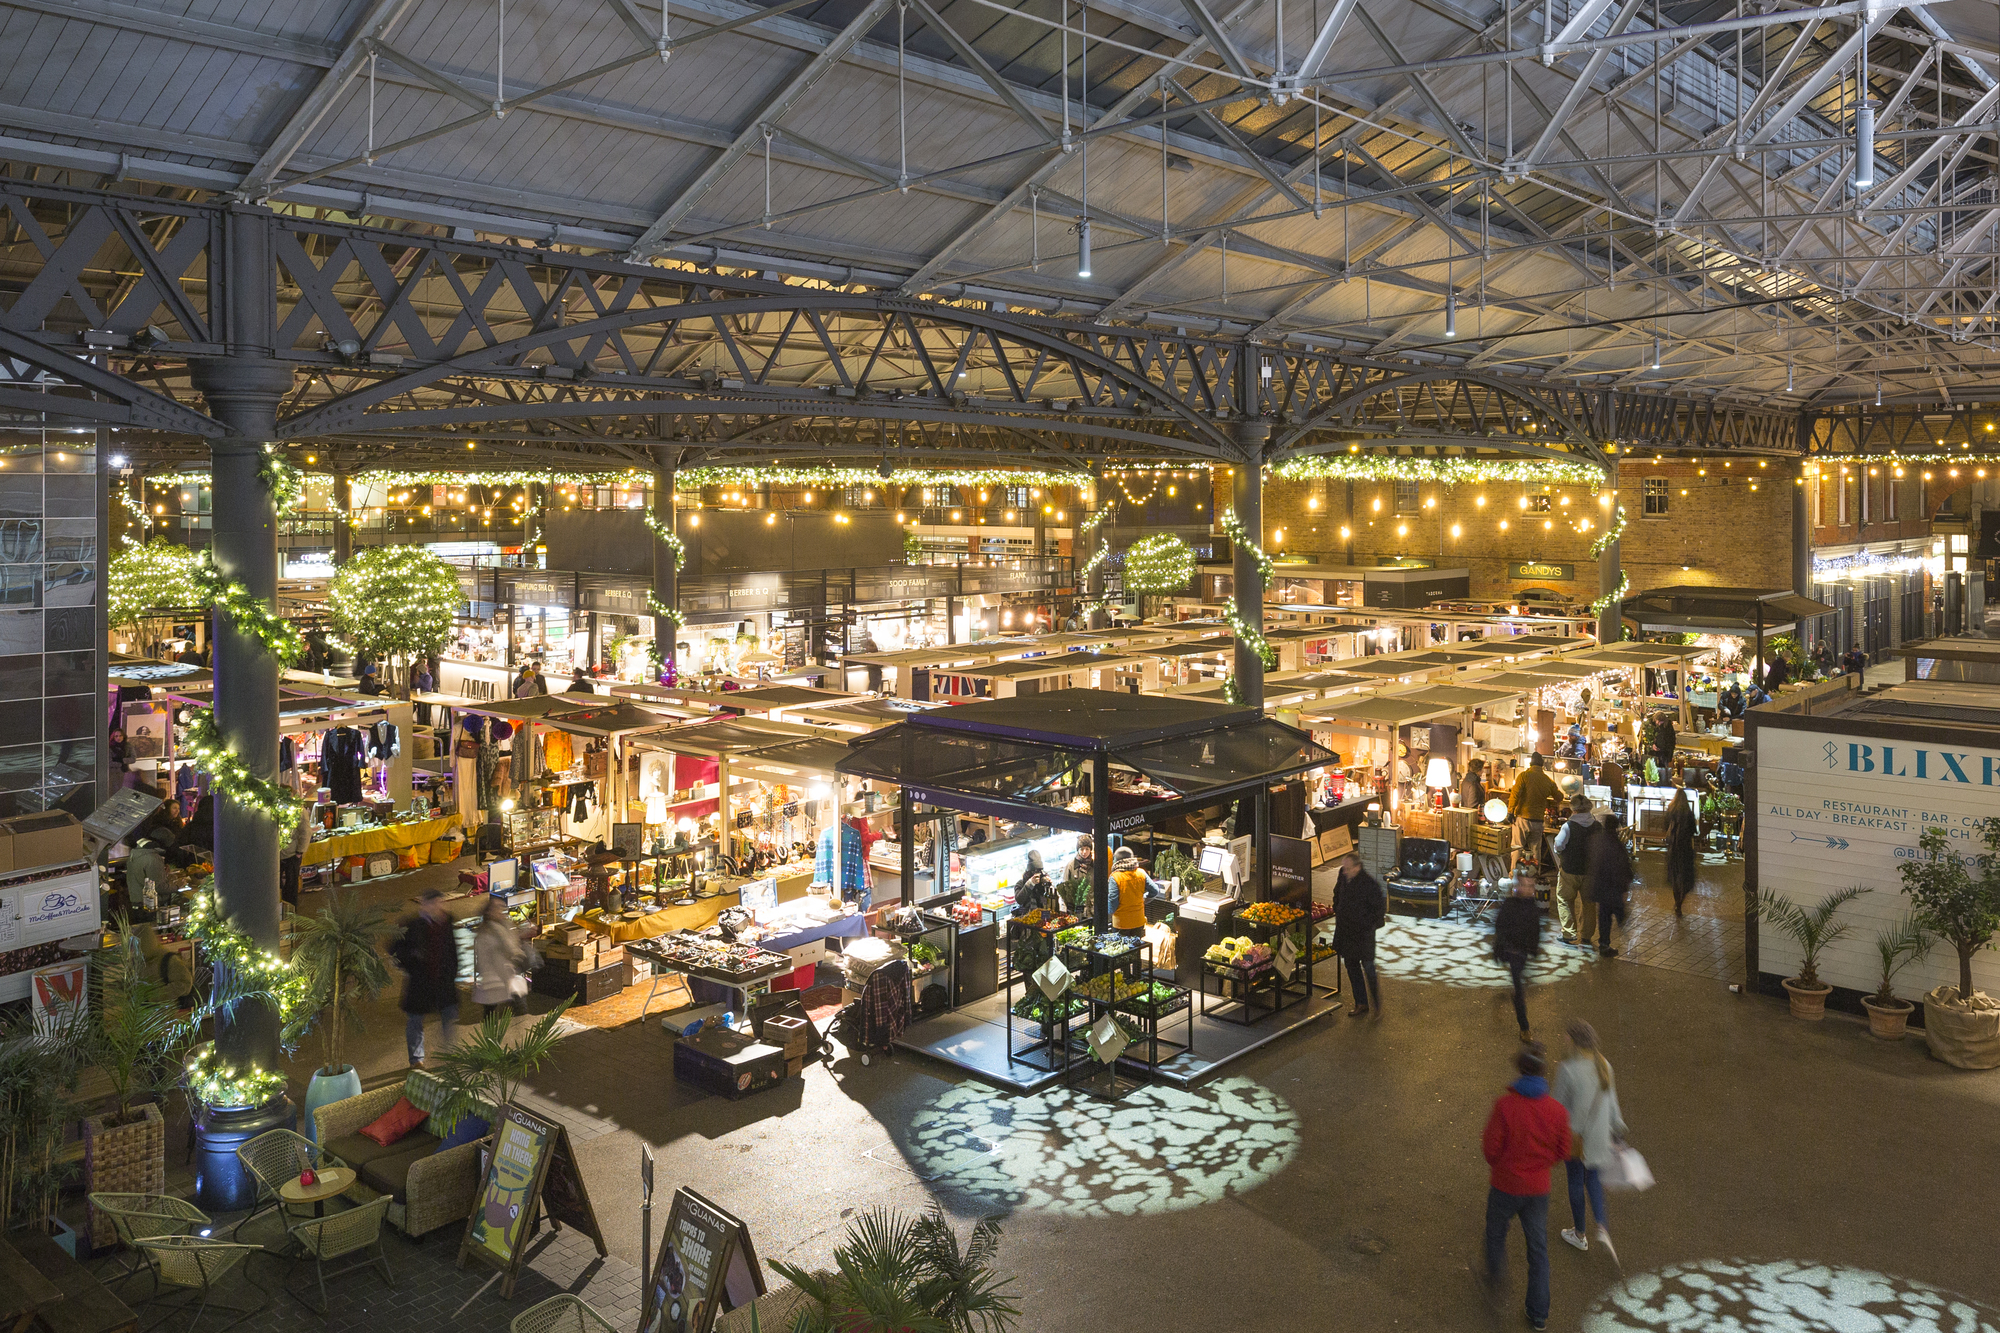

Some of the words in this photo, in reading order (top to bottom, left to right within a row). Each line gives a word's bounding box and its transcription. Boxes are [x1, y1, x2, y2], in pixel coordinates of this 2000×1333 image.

[1010, 571, 1027, 579] FLANK
[1519, 565, 1562, 576] GANDYS
[514, 582, 538, 591] DUMPLING
[538, 583, 555, 593] SHACK
[908, 578, 930, 587] FAMILY
[604, 589, 621, 598] BERBER
[627, 590, 633, 600] Q
[729, 588, 754, 597] BERBER
[755, 588, 761, 596] &
[762, 587, 769, 597] Q
[1770, 805, 1792, 817] ALL
[1796, 808, 1821, 820] DAY
[1832, 813, 1908, 831] BREAKFAST
[1823, 800, 1909, 819] RESTAURANT
[1921, 811, 1948, 824] BAR
[1109, 814, 1146, 831] NATOORA
[1282, 872, 1305, 881] FRONTIER
[513, 1112, 547, 1136] IGUANAS
[509, 1128, 531, 1149] HANG
[502, 1142, 512, 1157] IN
[511, 1145, 534, 1168] THERE
[687, 1202, 726, 1233] IGUANAS
[679, 1219, 698, 1239] TAPAS
[696, 1228, 706, 1243] TO
[680, 1236, 713, 1269] SHARE
[688, 1274, 707, 1290] YOURSELF
